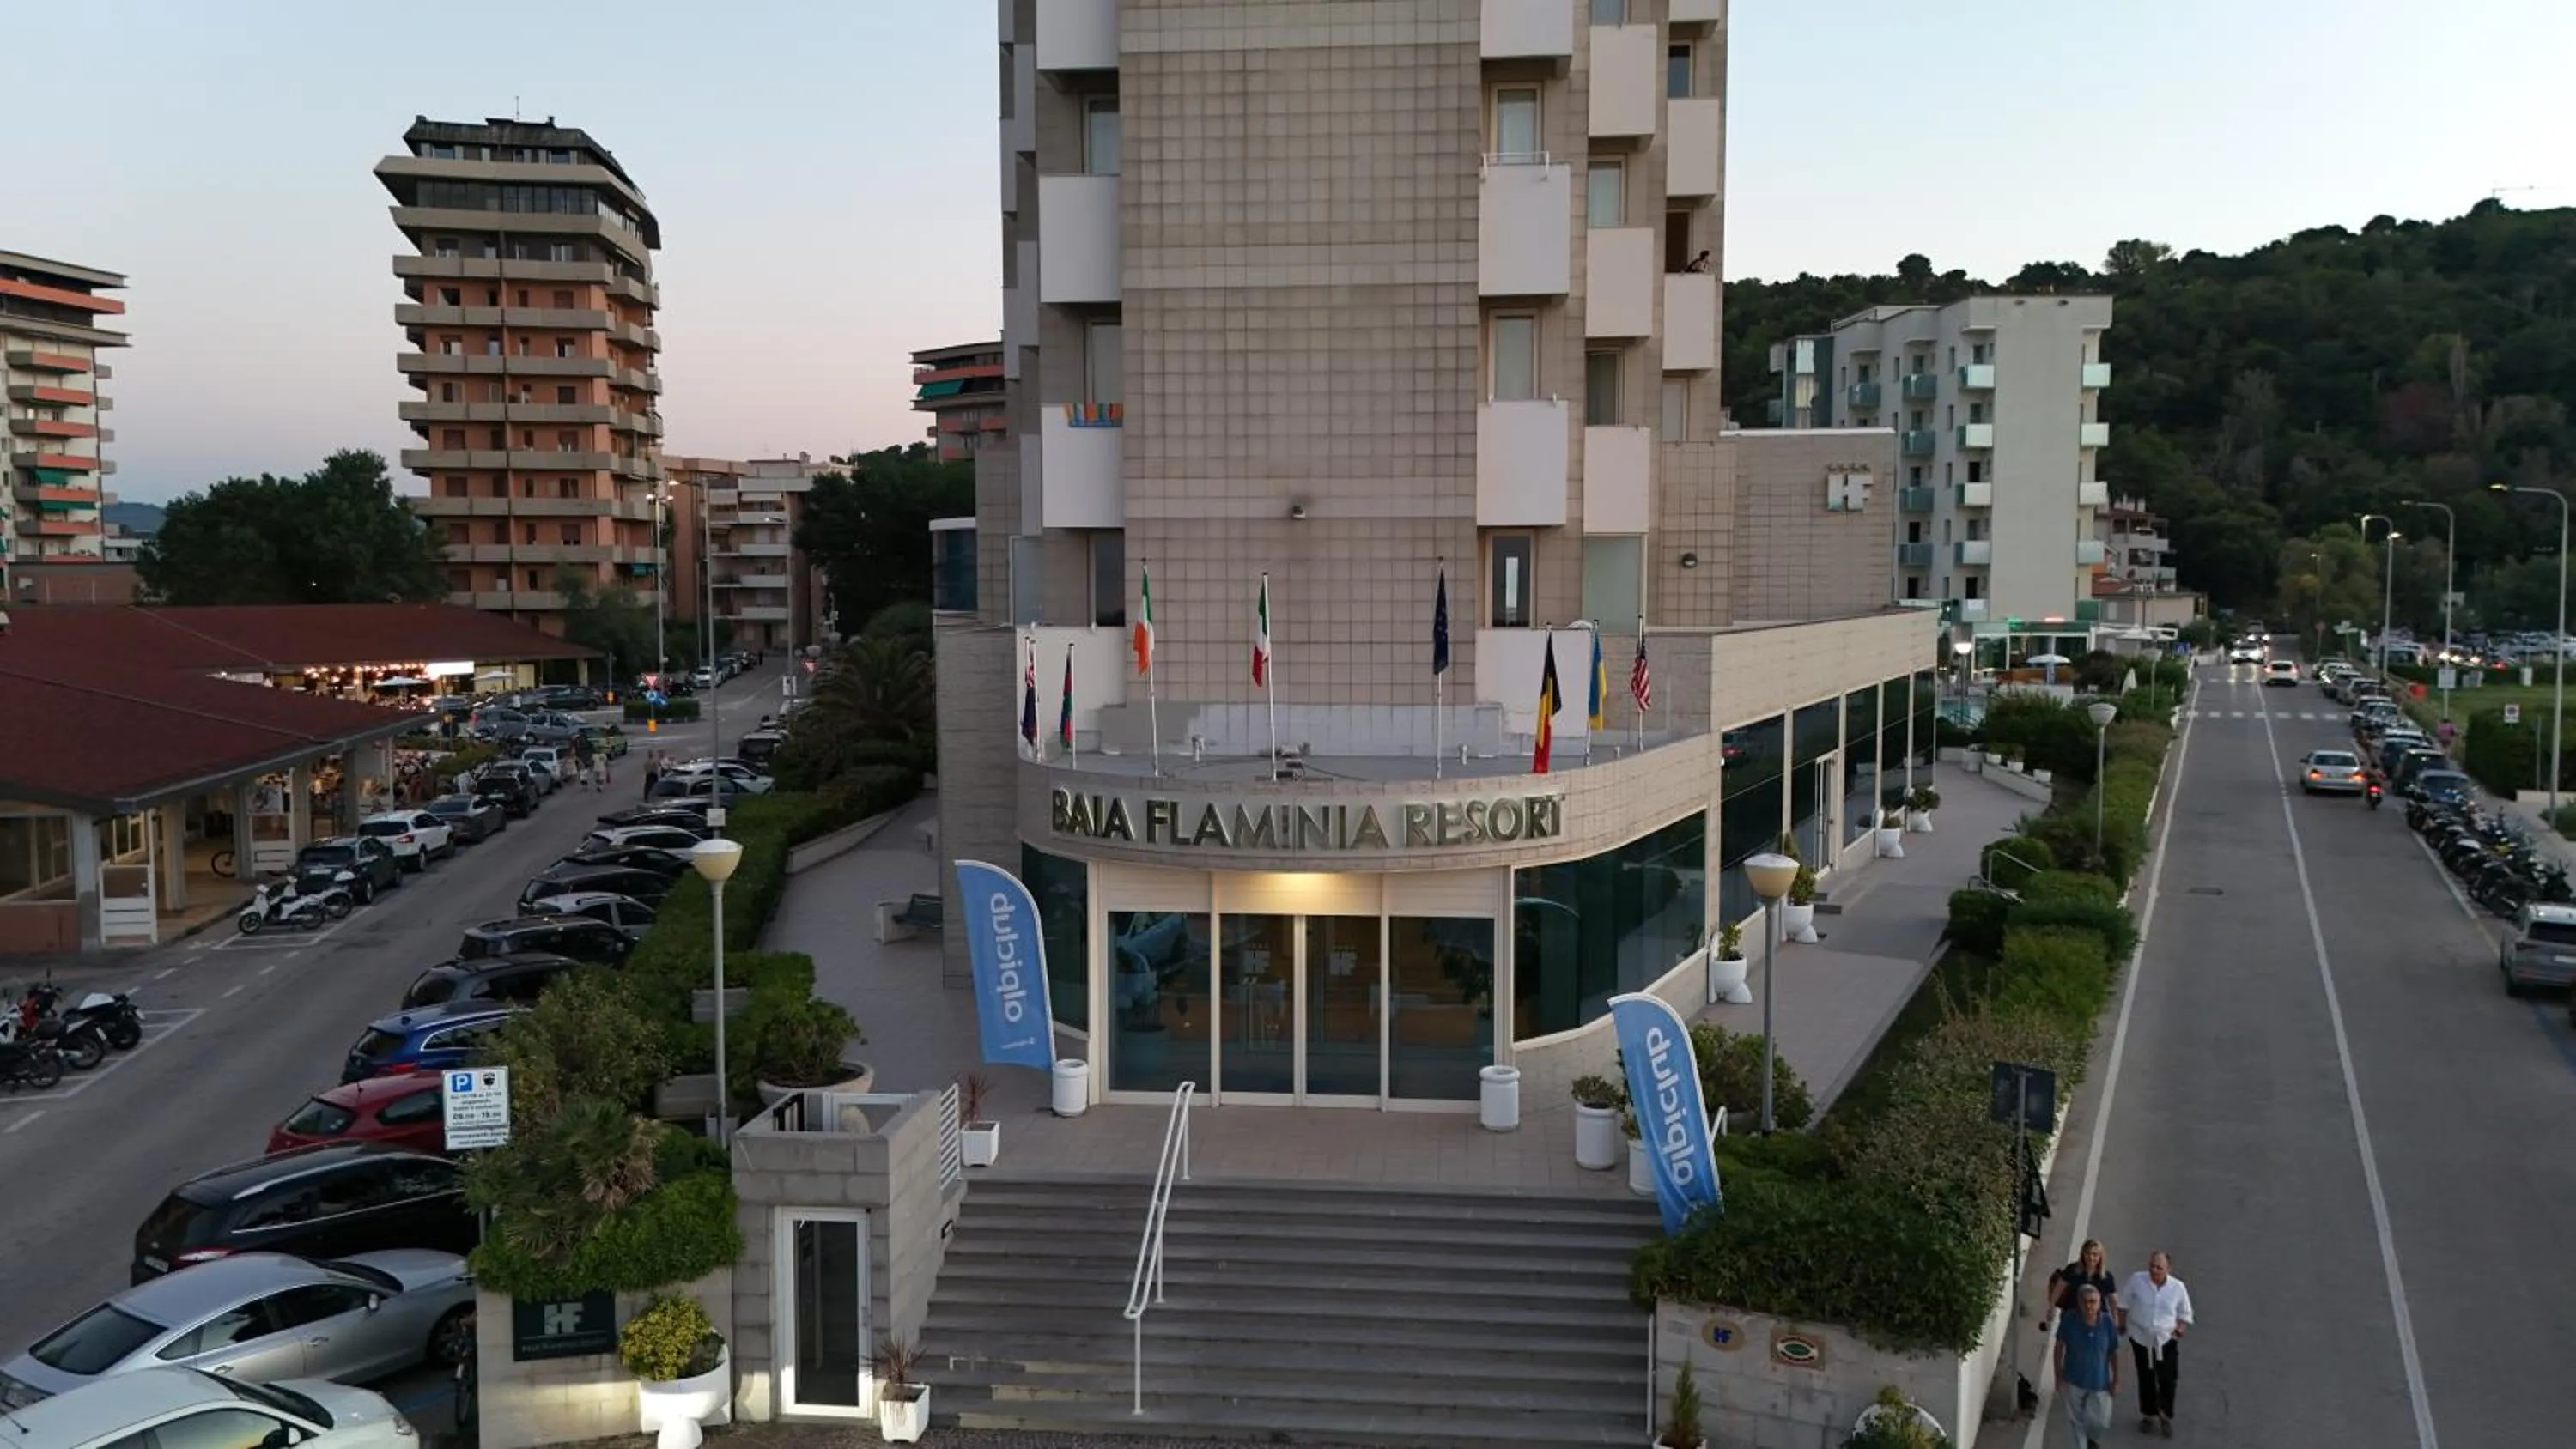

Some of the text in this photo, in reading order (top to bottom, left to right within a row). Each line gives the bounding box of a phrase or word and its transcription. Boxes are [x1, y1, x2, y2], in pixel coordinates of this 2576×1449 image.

[1052, 787, 1565, 850] BAIA FLAMINIA RESORT
